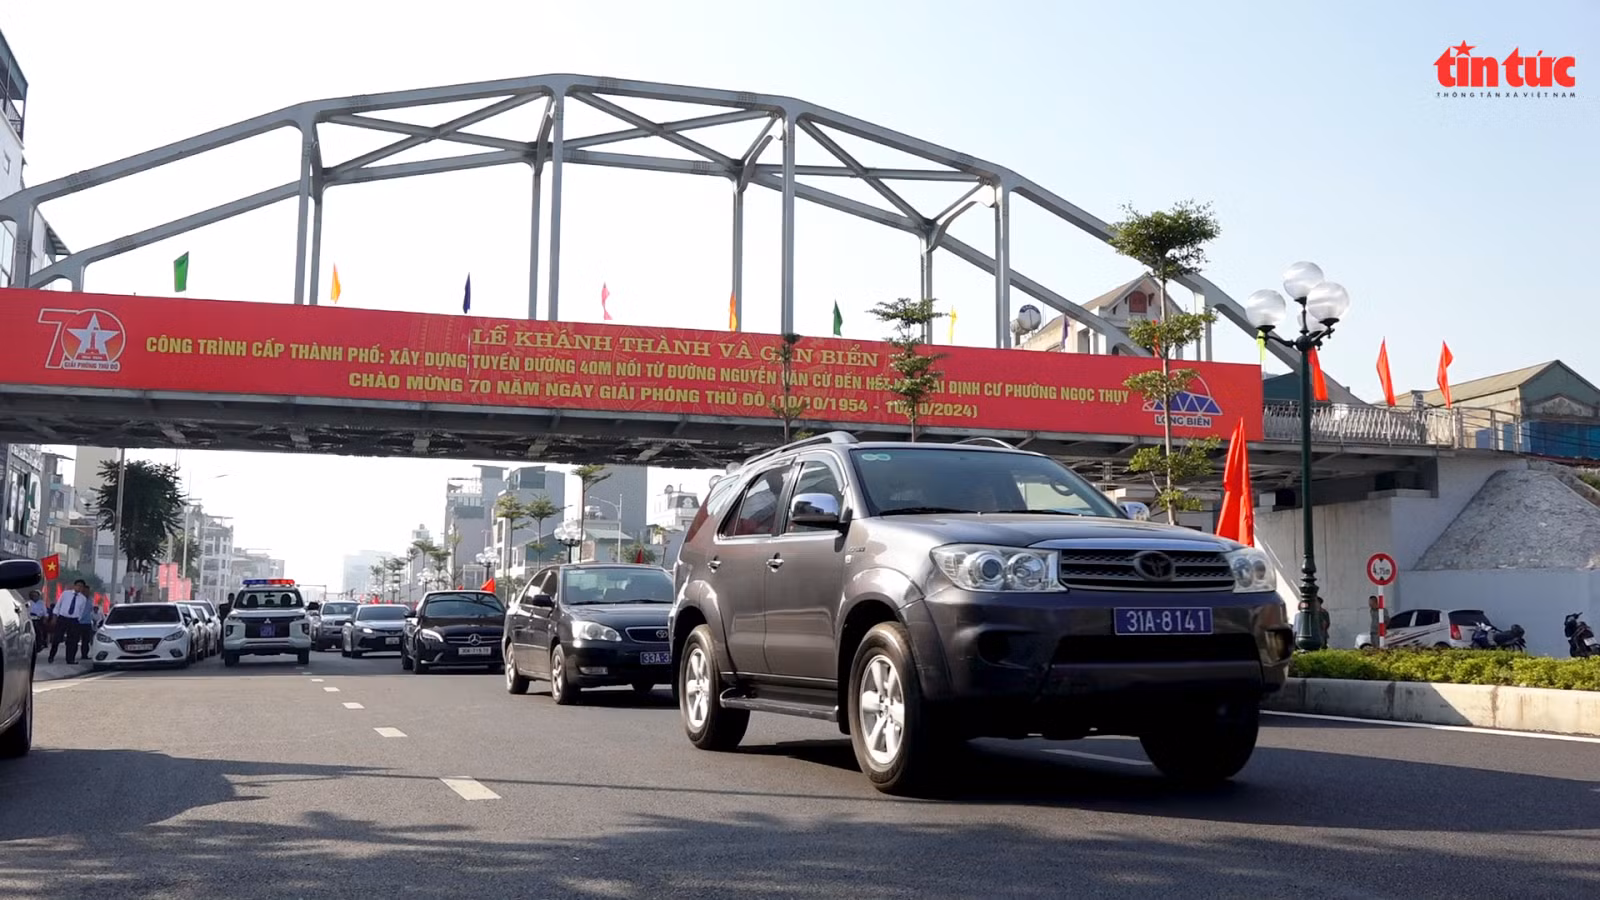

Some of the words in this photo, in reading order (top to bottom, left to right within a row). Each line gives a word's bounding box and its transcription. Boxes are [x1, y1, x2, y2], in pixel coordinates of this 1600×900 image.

[472, 324, 509, 346] LỄ
[515, 328, 612, 351] KHÁNH
[620, 335, 711, 357] THÀNH
[719, 341, 752, 359] VÀ
[760, 344, 814, 363] GN
[821, 344, 879, 367] BIỂN
[146, 334, 193, 354] CÔNG
[198, 338, 247, 357] TRÌNH
[252, 338, 285, 358] CẤP
[290, 341, 343, 361] THÀNH
[348, 343, 385, 364] PHỐ:
[389, 347, 420, 366] XÂY
[425, 351, 467, 370] DỰNG
[472, 351, 520, 371] TUYẾN
[524, 355, 576, 374] ĐƯỜNG
[580, 360, 611, 376] 40M
[616, 358, 641, 377] NỐI
[646, 362, 665, 379] TỪ
[668, 363, 716, 381] ĐƯỜNG
[721, 365, 777, 385] NGUYỄN
[812, 371, 833, 388] CỪ
[835, 371, 862, 389] ĐẾN
[949, 381, 981, 398] ĐỊNH
[984, 381, 1003, 397] CƯ
[1005, 382, 1057, 400] PHƯỜNG
[1060, 386, 1095, 404] NGỌC
[1098, 388, 1129, 406] THỤY
[349, 370, 401, 390] CHÀO
[406, 373, 464, 393] MỪNG
[469, 379, 492, 394] 70
[497, 378, 540, 396] NĂM
[545, 381, 594, 399] NGÀY
[599, 381, 635, 401] GIẢI
[640, 385, 700, 404] PHÓNG
[705, 388, 738, 406] THỦ
[743, 388, 766, 407] ĐÔ
[886, 400, 978, 418] 10/0/2024)
[1186, 415, 1211, 427] BIÊN
[1126, 610, 1205, 632] 31A-8141
[643, 652, 671, 663] 33A-3
